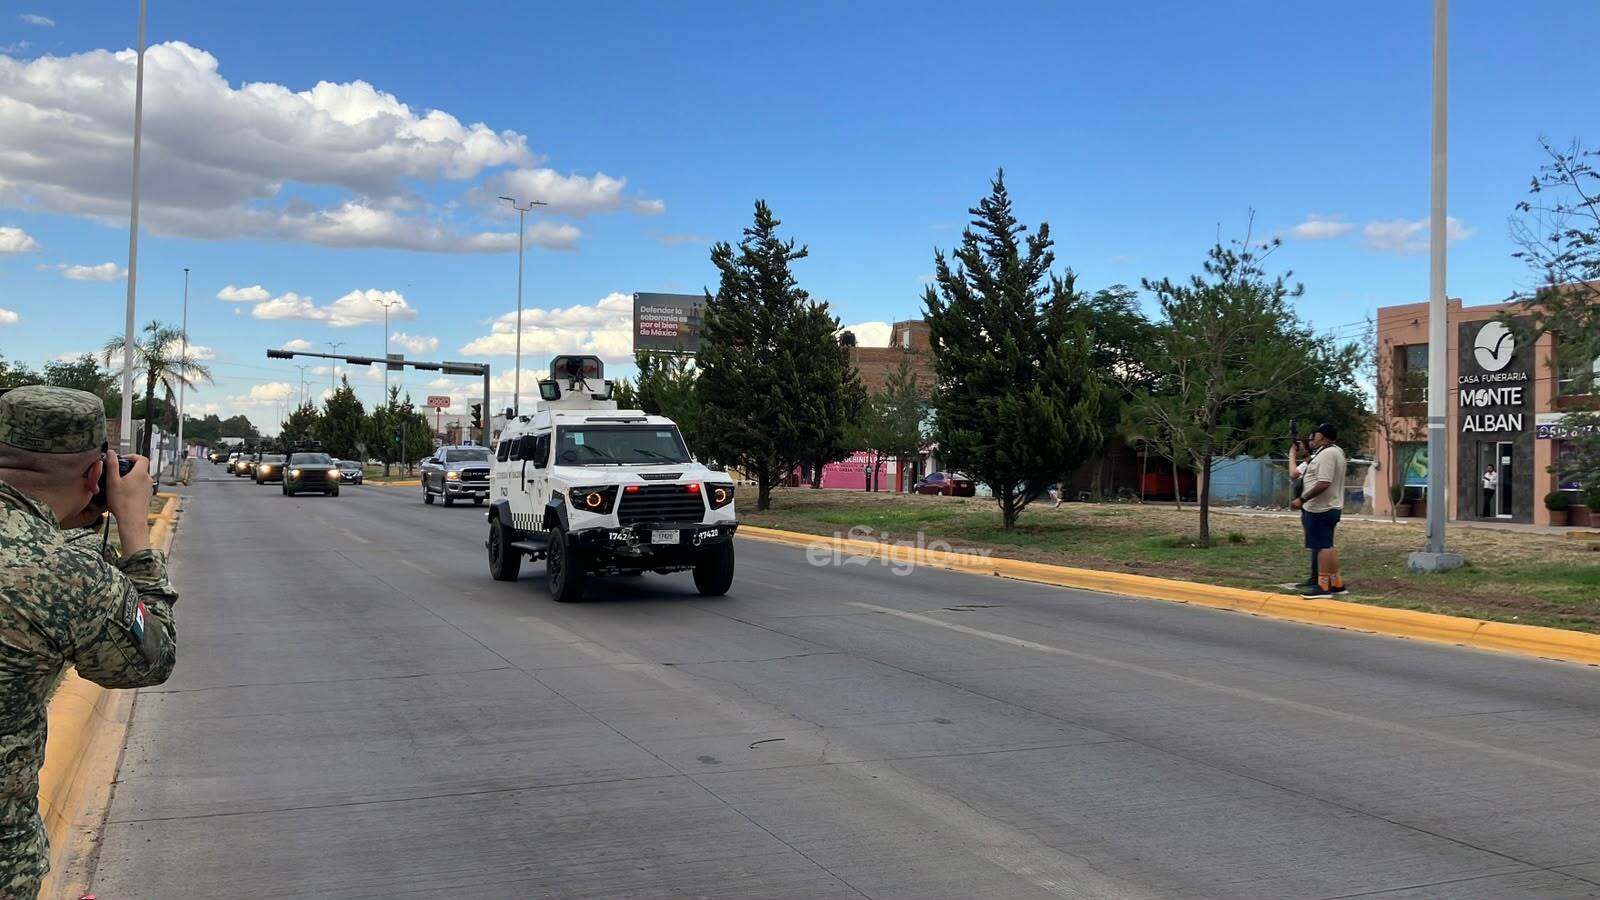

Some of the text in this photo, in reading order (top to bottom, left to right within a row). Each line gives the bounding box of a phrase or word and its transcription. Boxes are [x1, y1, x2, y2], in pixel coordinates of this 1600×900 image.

[640, 305, 682, 315] Defender la
[640, 313, 678, 322] soberanía
[640, 328, 678, 337] de México
[1458, 371, 1528, 384] CASA FUNERARIA
[1460, 387, 1522, 407] MONTE
[1462, 413, 1522, 432] ALBAN
